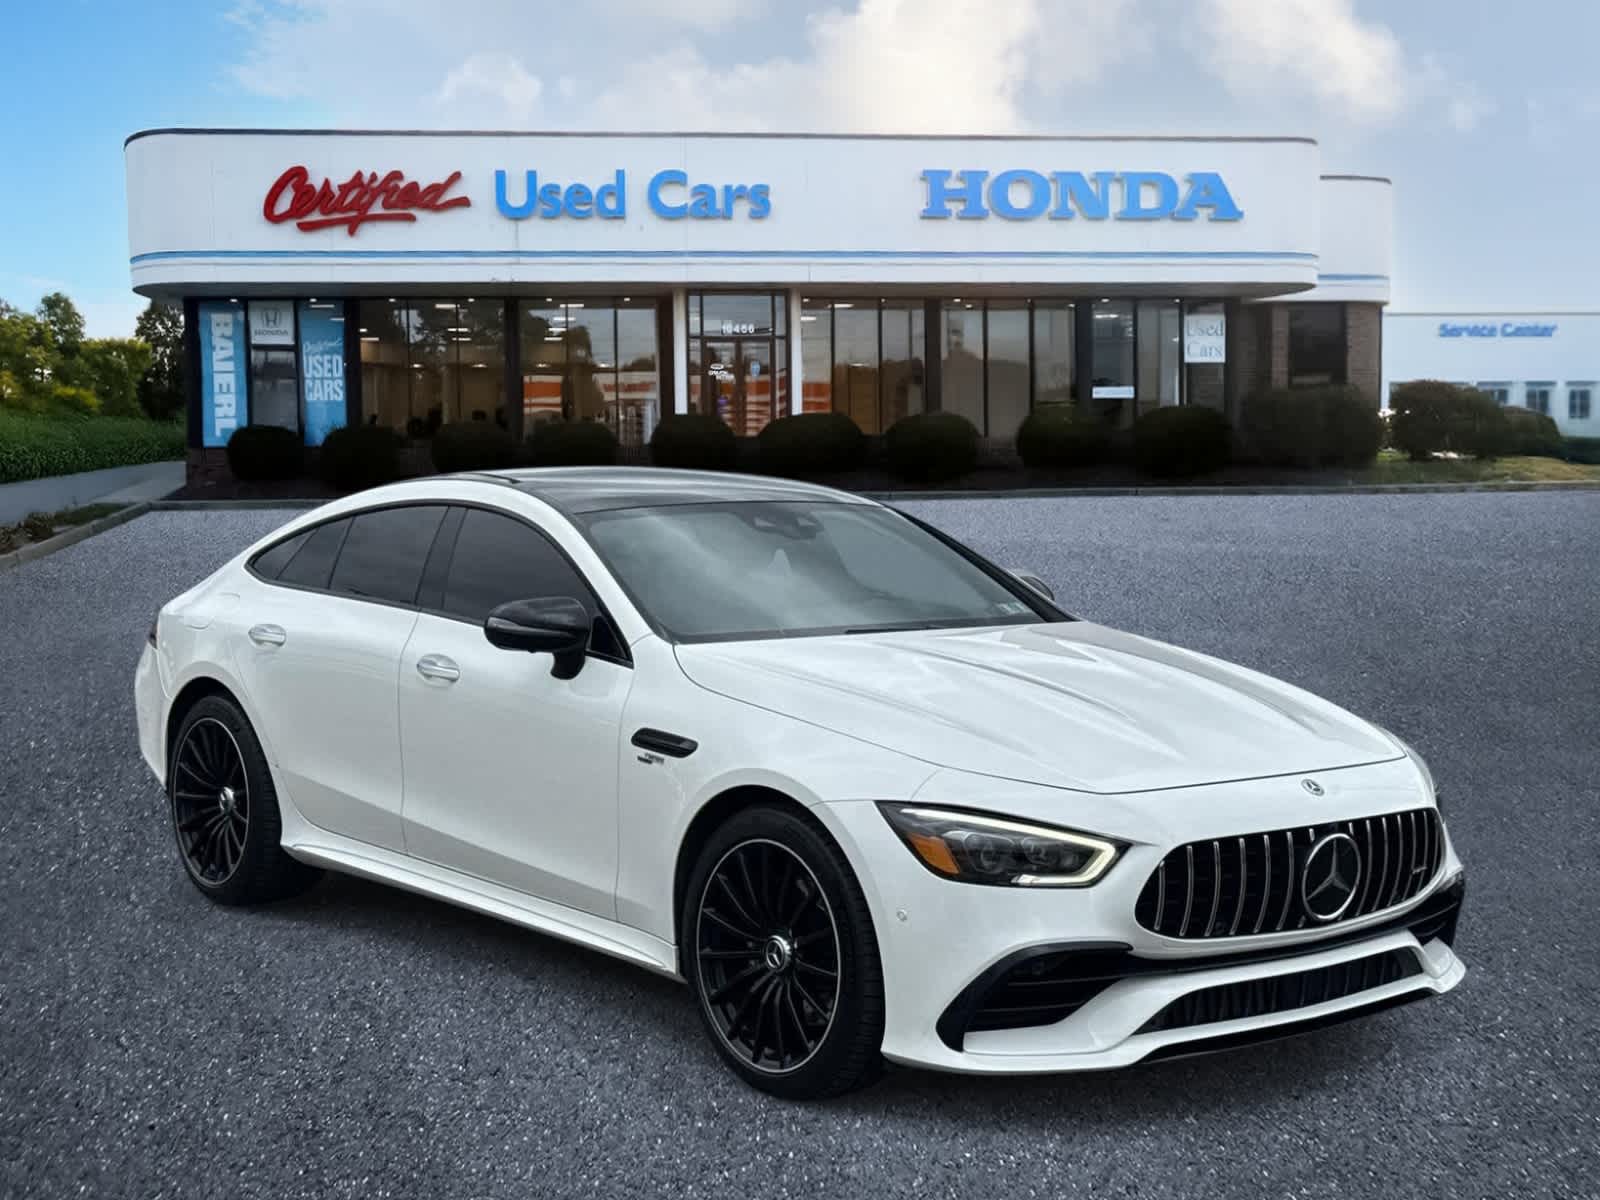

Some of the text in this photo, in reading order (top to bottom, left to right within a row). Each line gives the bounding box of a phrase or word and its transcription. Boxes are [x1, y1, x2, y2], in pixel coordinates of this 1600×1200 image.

[263, 166, 772, 236] Certified Used Cars
[920, 169, 1244, 220] HONDA
[1186, 319, 1225, 337] Used
[1186, 343, 1224, 358] Cars
[211, 312, 237, 437] BAIERL
[303, 354, 343, 378] USED
[304, 379, 344, 402] CARS
